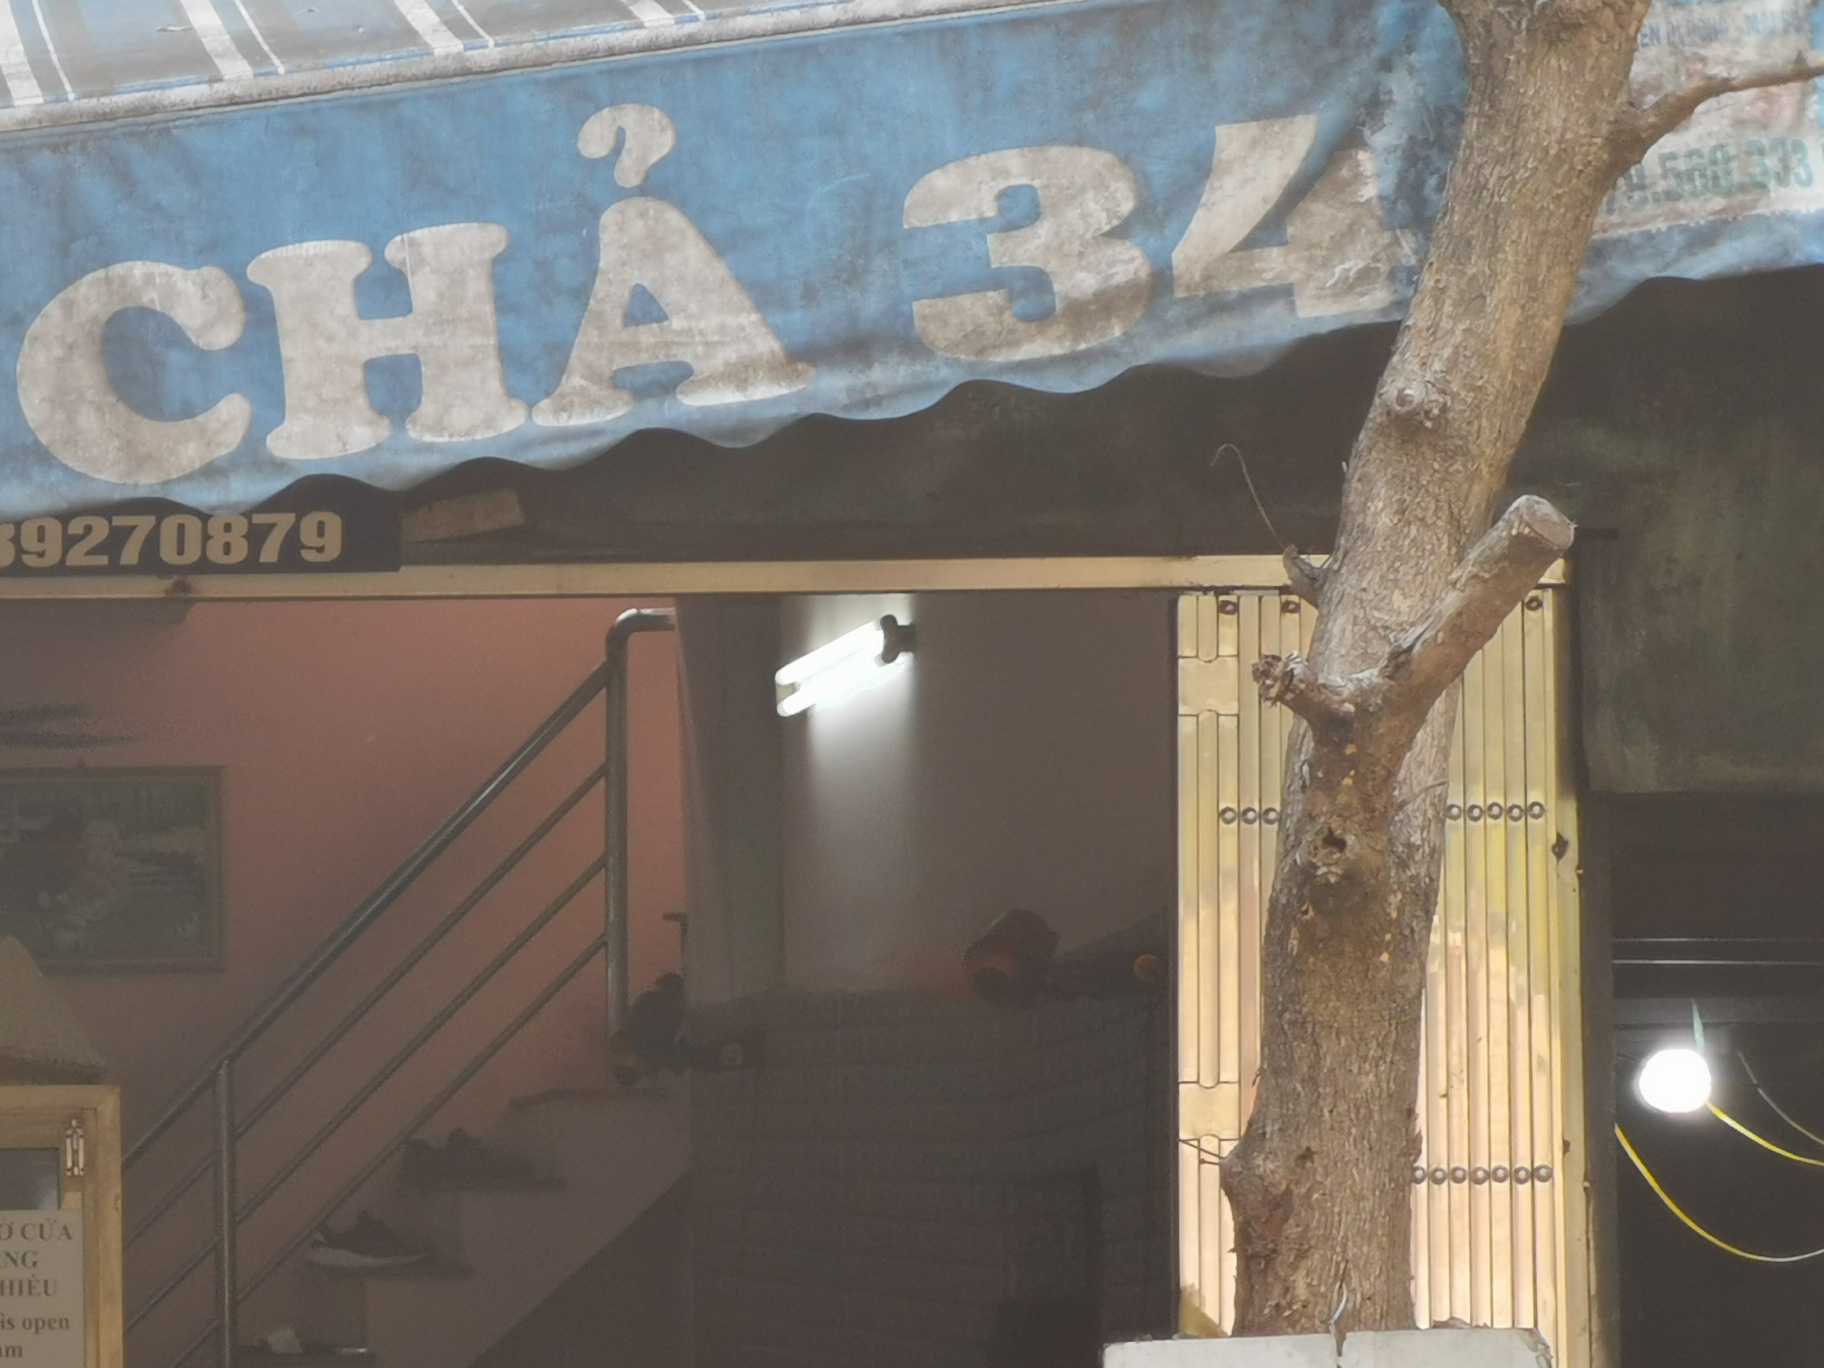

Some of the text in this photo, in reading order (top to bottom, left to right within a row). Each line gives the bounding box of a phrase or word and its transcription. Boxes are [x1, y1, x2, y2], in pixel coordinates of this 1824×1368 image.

[17, 103, 816, 483] CHẢ
[903, 115, 1416, 362] 34
[0, 1312, 15, 1330] is
[22, 1317, 70, 1335] open
